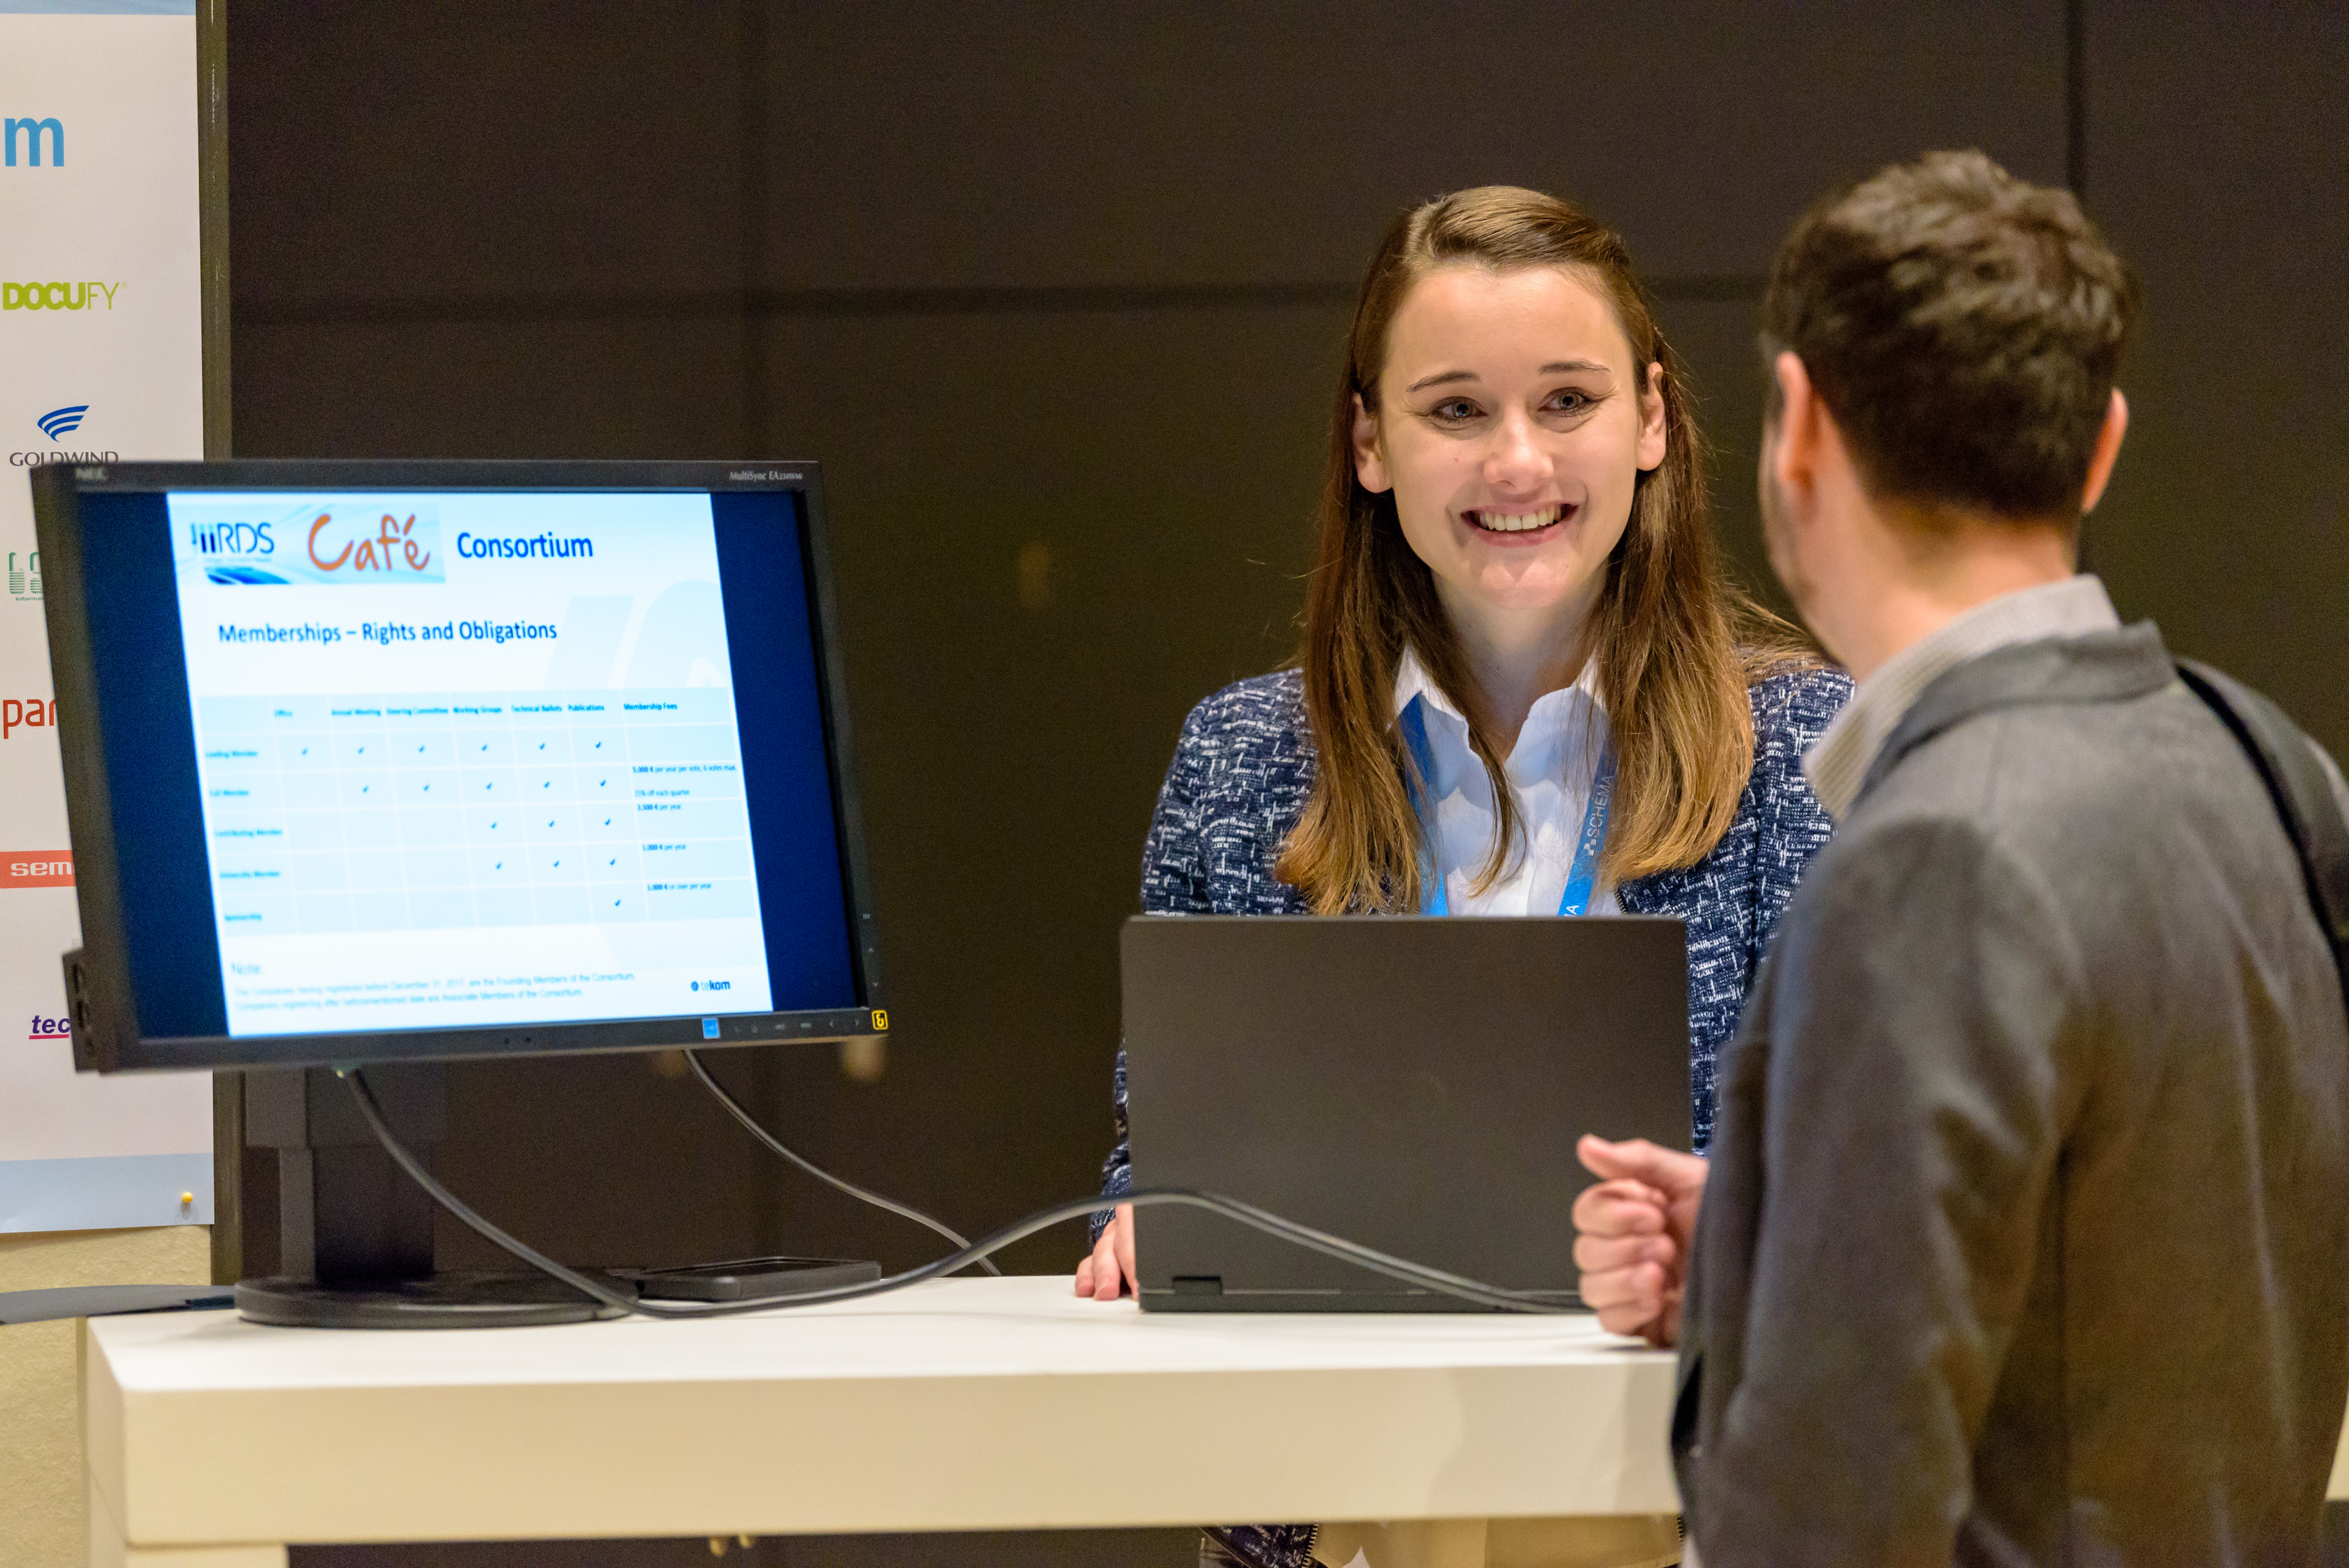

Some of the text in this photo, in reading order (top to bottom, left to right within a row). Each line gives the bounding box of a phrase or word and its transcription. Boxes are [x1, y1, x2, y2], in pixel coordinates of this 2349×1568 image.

[730, 471, 766, 482] MultiSync
[308, 513, 430, 571] Café
[458, 531, 593, 558] Consortium
[219, 623, 341, 645] Memberships
[362, 622, 416, 645] Rights
[422, 622, 454, 641] and
[459, 621, 557, 643] Obligations
[453, 706, 479, 715] Working
[624, 703, 662, 712] Membership
[669, 789, 690, 798] quarter
[1587, 775, 1614, 838] SCHEMA
[11, 861, 72, 876] sem
[496, 976, 531, 988] Founding
[533, 975, 567, 985] Members
[569, 974, 578, 984] of
[579, 974, 590, 983] the
[700, 979, 731, 991] tekom
[480, 991, 515, 1000] Members
[516, 990, 525, 999] of
[526, 989, 537, 998] the
[32, 1015, 71, 1034] tec
